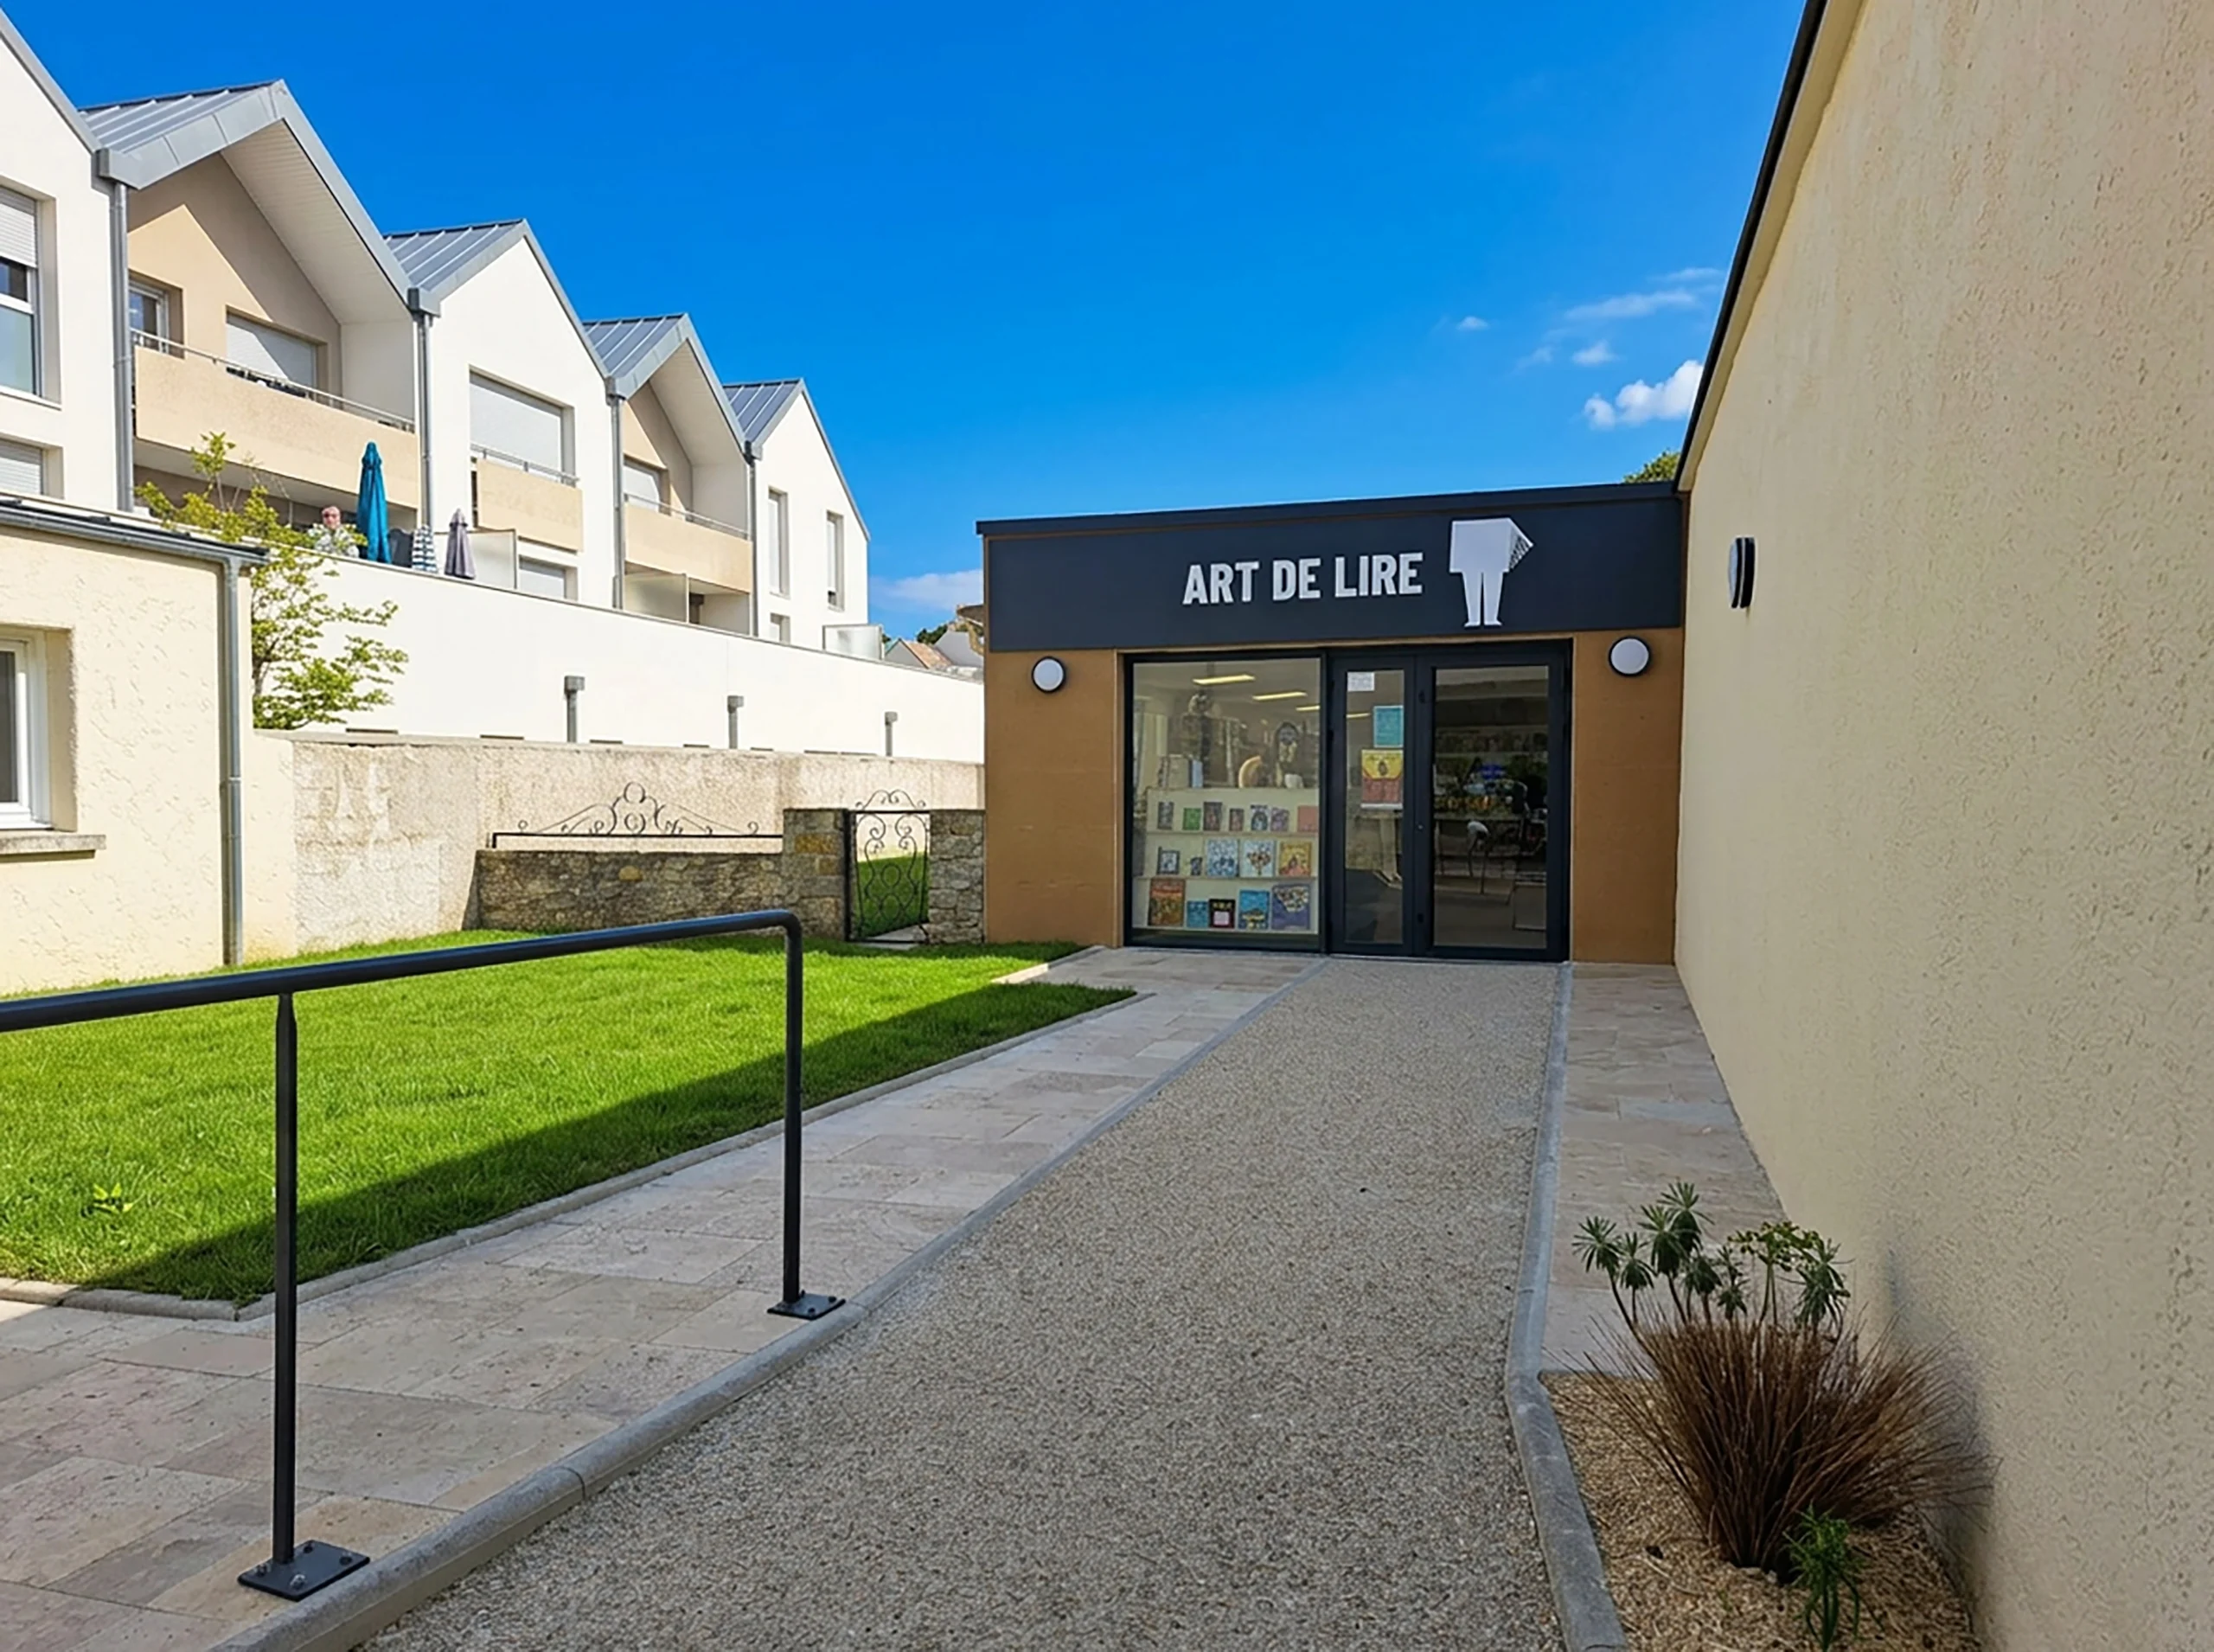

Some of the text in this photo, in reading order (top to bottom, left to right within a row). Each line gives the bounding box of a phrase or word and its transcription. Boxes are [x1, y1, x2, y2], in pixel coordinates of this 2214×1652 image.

[1182, 552, 1424, 605] ART DE LIRE
